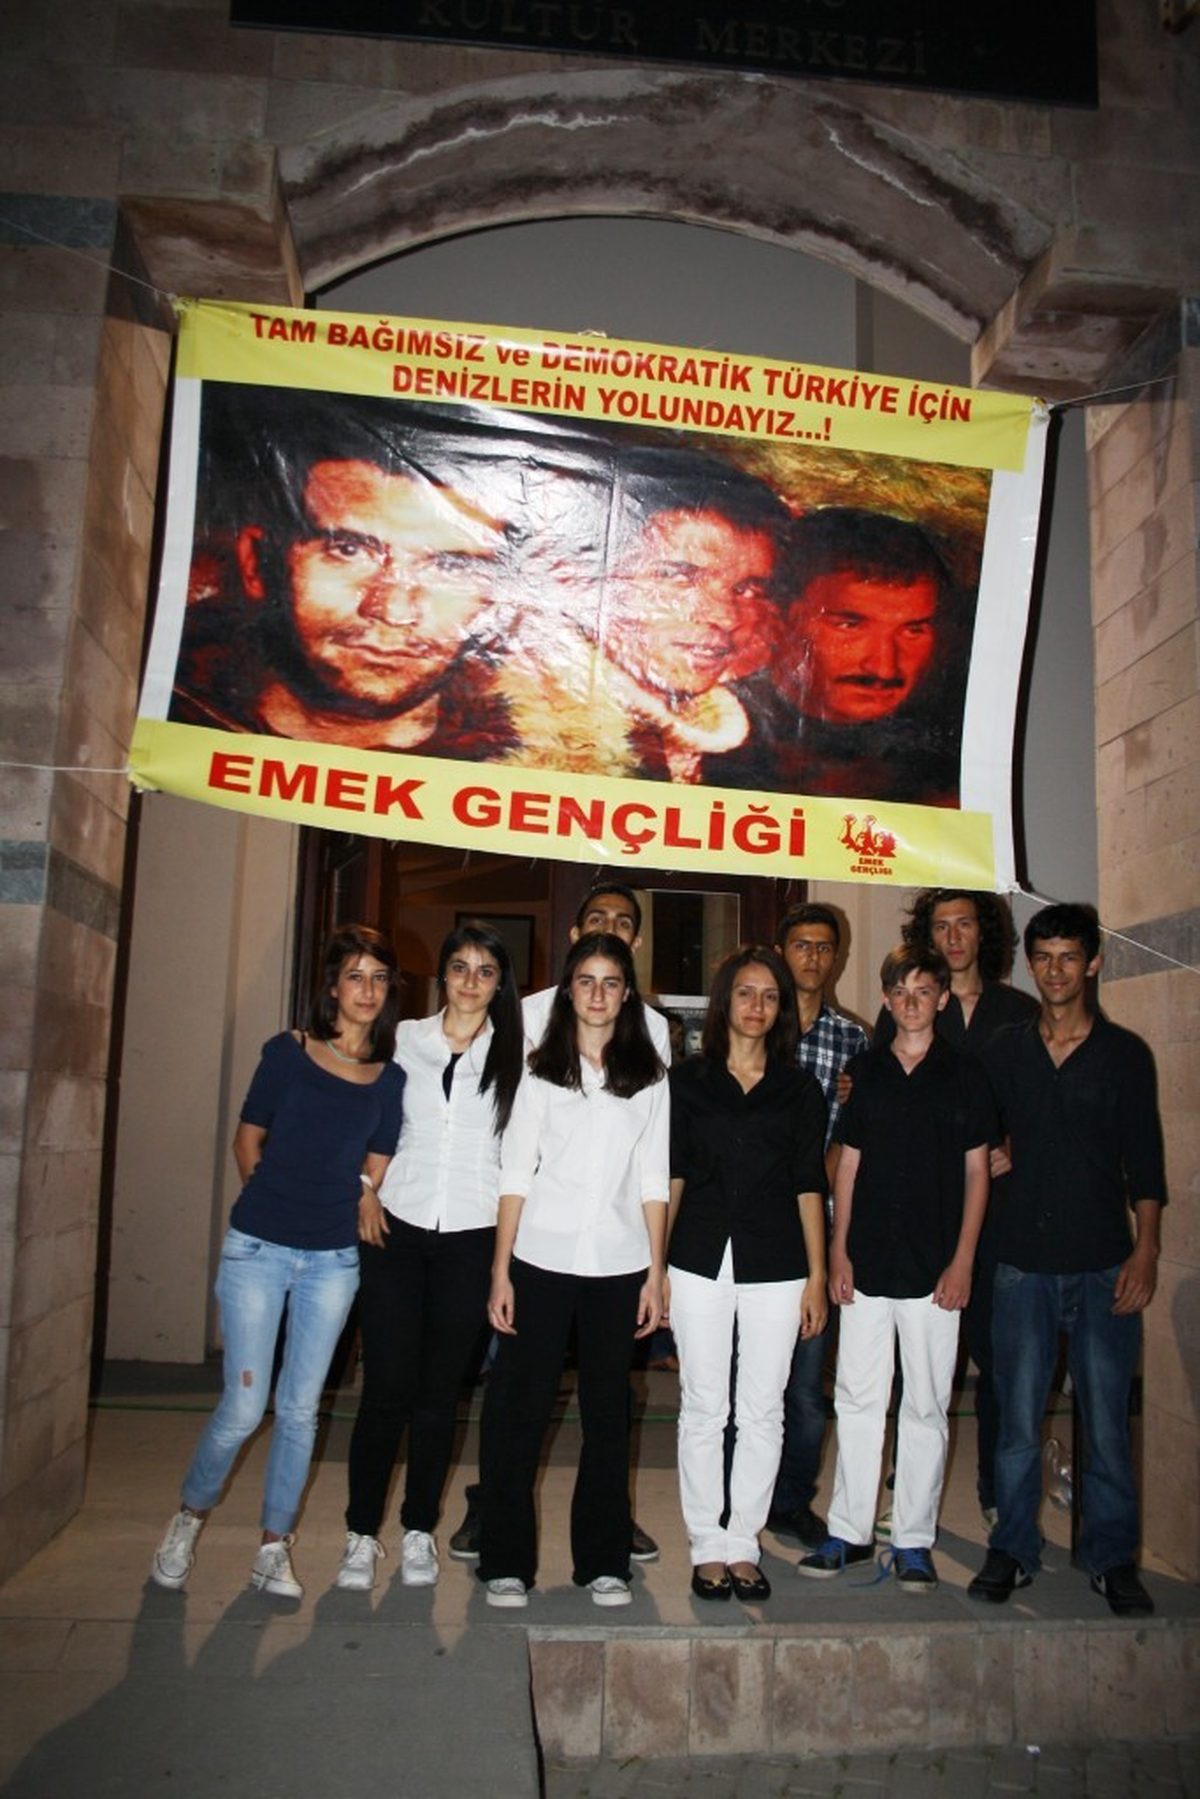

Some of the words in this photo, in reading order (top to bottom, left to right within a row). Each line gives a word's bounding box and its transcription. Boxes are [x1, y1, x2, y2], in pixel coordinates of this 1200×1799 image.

[694, 17, 927, 75] MERKEZİ
[249, 313, 318, 344] TAM
[326, 320, 486, 363] BAĞIMSIZ
[496, 345, 531, 368] ve
[540, 341, 752, 393] DEMOKRATİK
[763, 366, 900, 415] TÜRKİYE
[907, 383, 973, 424] İÇİN
[391, 364, 587, 412] DENİZLERİN
[597, 387, 834, 442] YOLUNDAYIZ...!
[207, 750, 426, 821] EMEK
[450, 785, 808, 858] GENÇLİĞİ
[859, 857, 884, 865] EMEK
